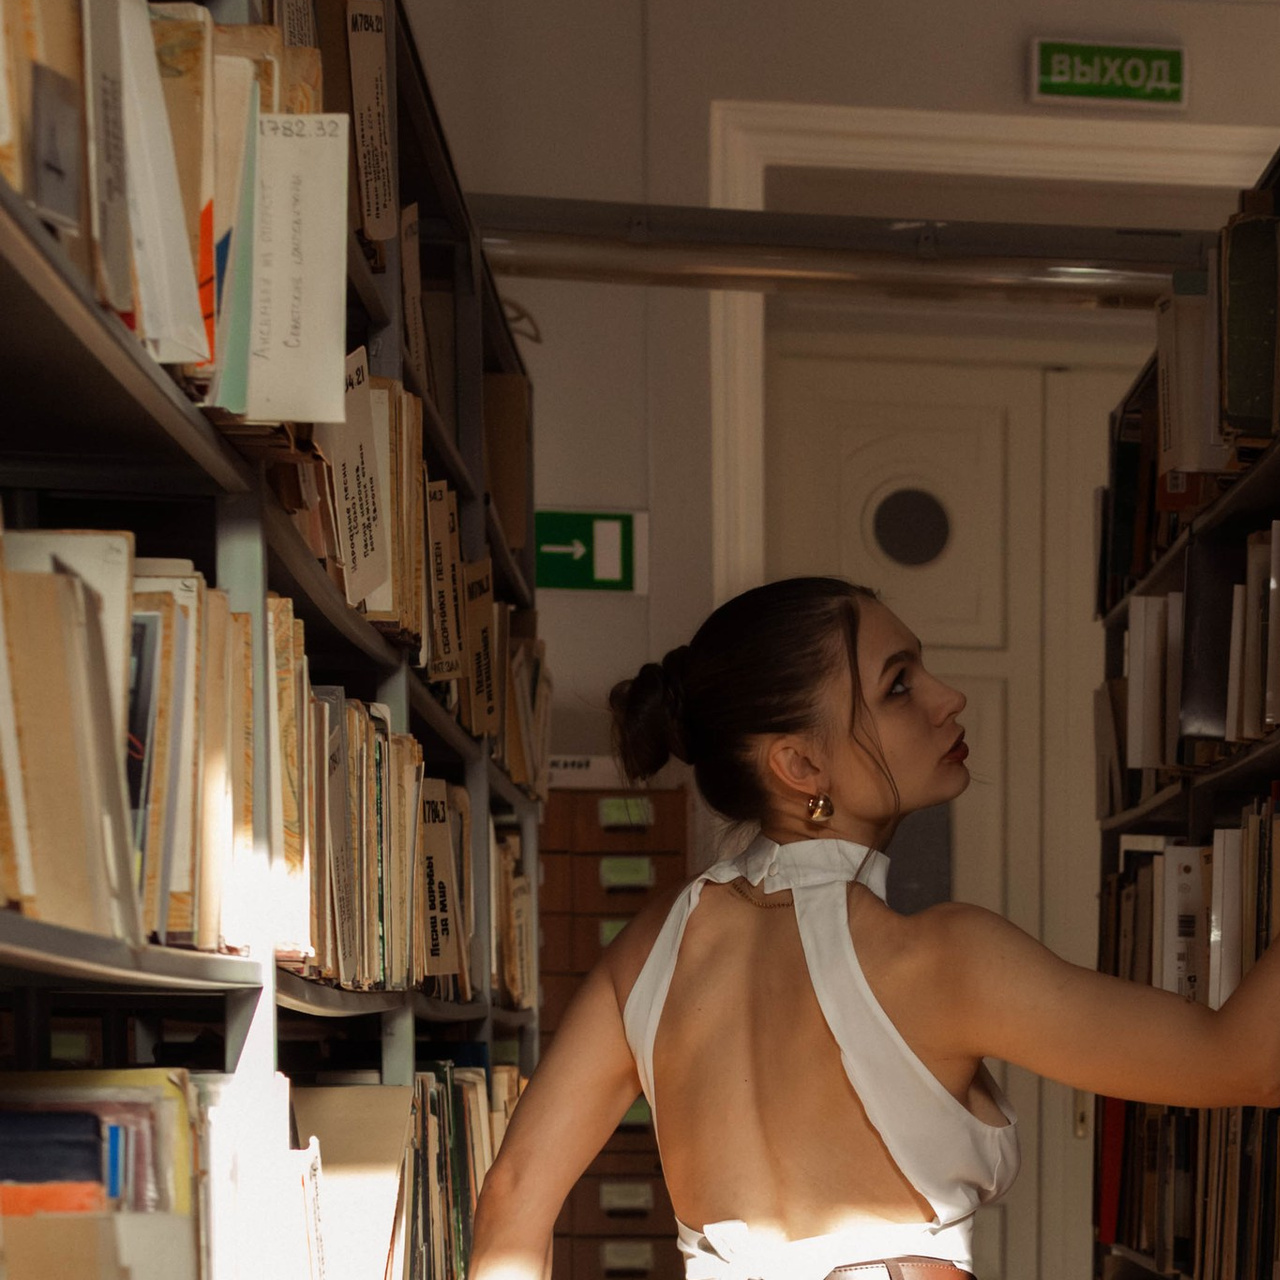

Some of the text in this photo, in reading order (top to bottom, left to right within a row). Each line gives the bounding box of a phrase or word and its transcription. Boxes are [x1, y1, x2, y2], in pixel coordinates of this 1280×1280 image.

[1050, 54, 1173, 95] ВЫХОД
[434, 541, 445, 582] ПЕСЕН
[425, 855, 436, 911] БОРЬБЫ
[437, 880, 450, 936] ЗА МИР
